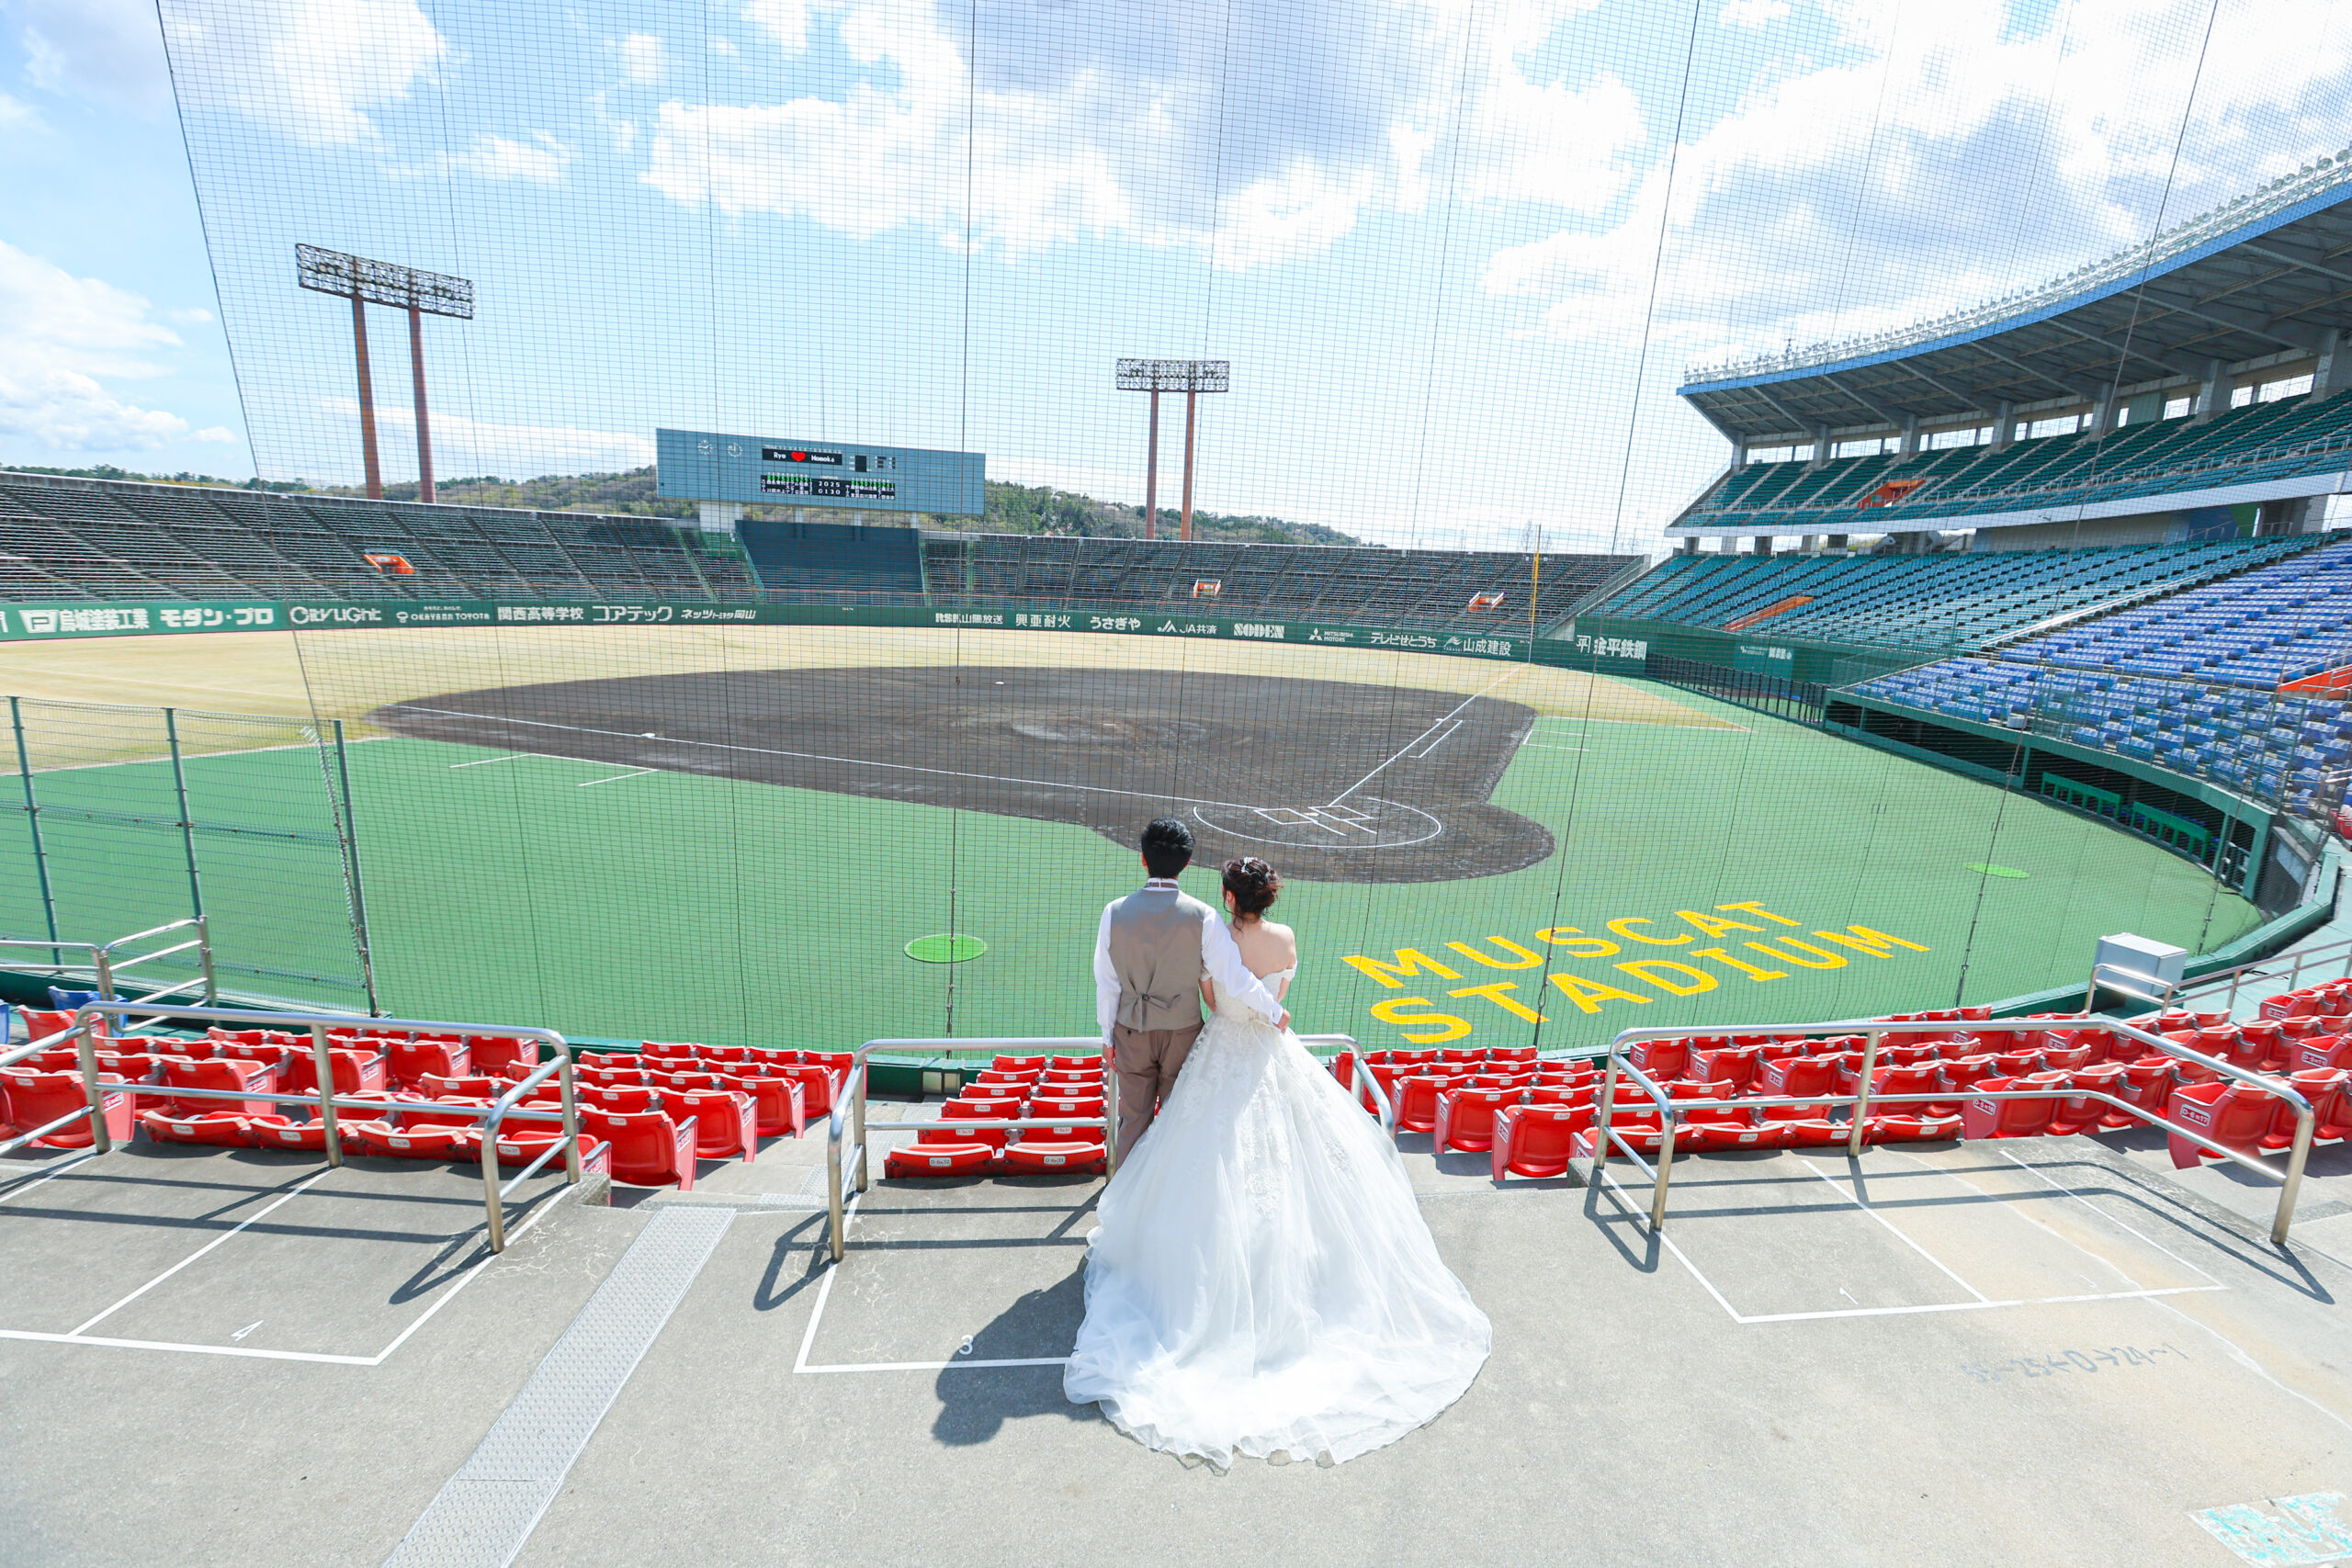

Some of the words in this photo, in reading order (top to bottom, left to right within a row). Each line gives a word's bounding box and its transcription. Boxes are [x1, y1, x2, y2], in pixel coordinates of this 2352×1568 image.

[774, 451, 786, 459] Ryo
[497, 606, 584, 621] 関西高等学校
[592, 606, 673, 622] コアテック
[681, 609, 756, 620] ネッツトヨタ岡山
[1015, 614, 1071, 628] 興亜耐火
[1091, 616, 1141, 631] うさぎや
[1179, 625, 1217, 635] JA共済
[1234, 623, 1284, 639] SODEN
[1324, 630, 1353, 638] MITSUBISHI
[1371, 632, 1438, 649] テレビせとうち
[1463, 637, 1511, 657] 山成建設
[1341, 900, 1802, 989] MUSCAT
[1370, 924, 1930, 1043] STADIUM
[231, 1320, 264, 1342] 4
[958, 1334, 974, 1356] 3
